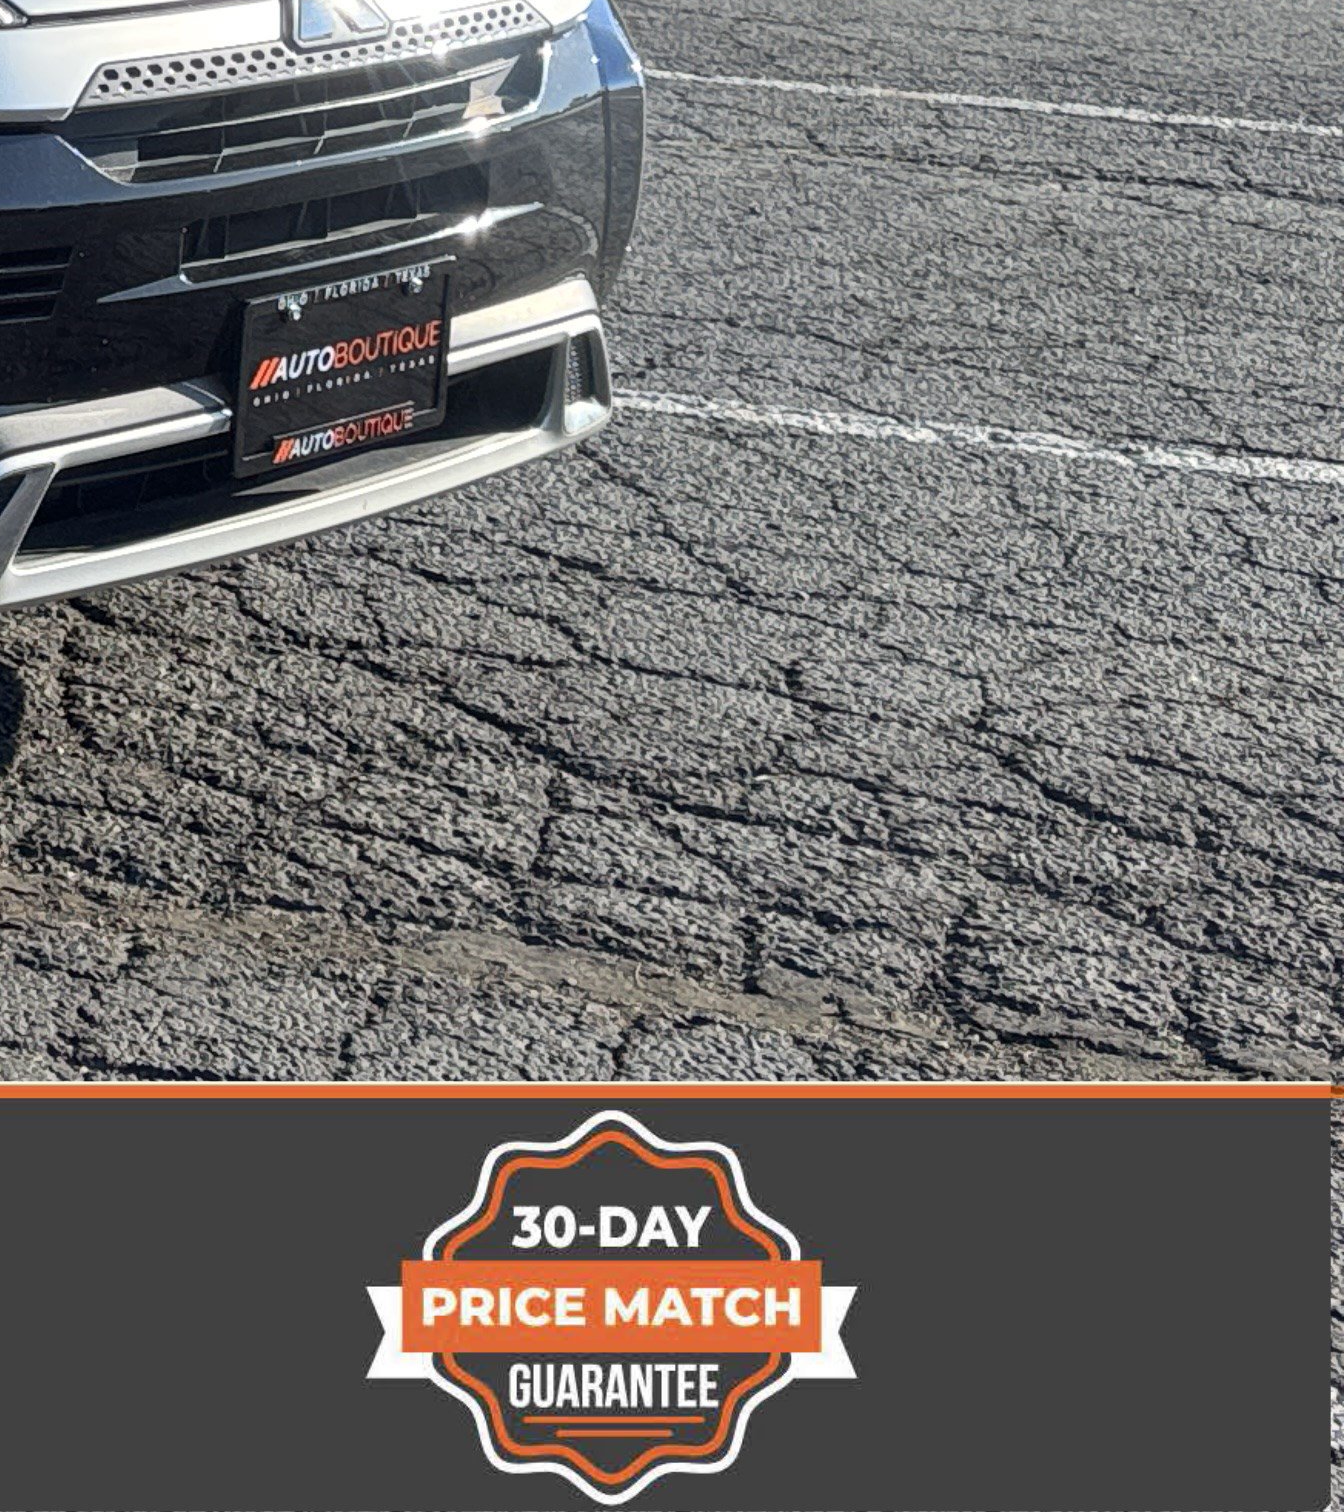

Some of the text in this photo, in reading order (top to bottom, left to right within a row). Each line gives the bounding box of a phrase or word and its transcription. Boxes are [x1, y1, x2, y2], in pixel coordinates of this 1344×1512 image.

[270, 319, 442, 384] AUTOBOUTIQUE
[252, 354, 435, 407] OHIO FLORIDA TEXAS
[288, 407, 414, 459] AUTOBOUTIQUE
